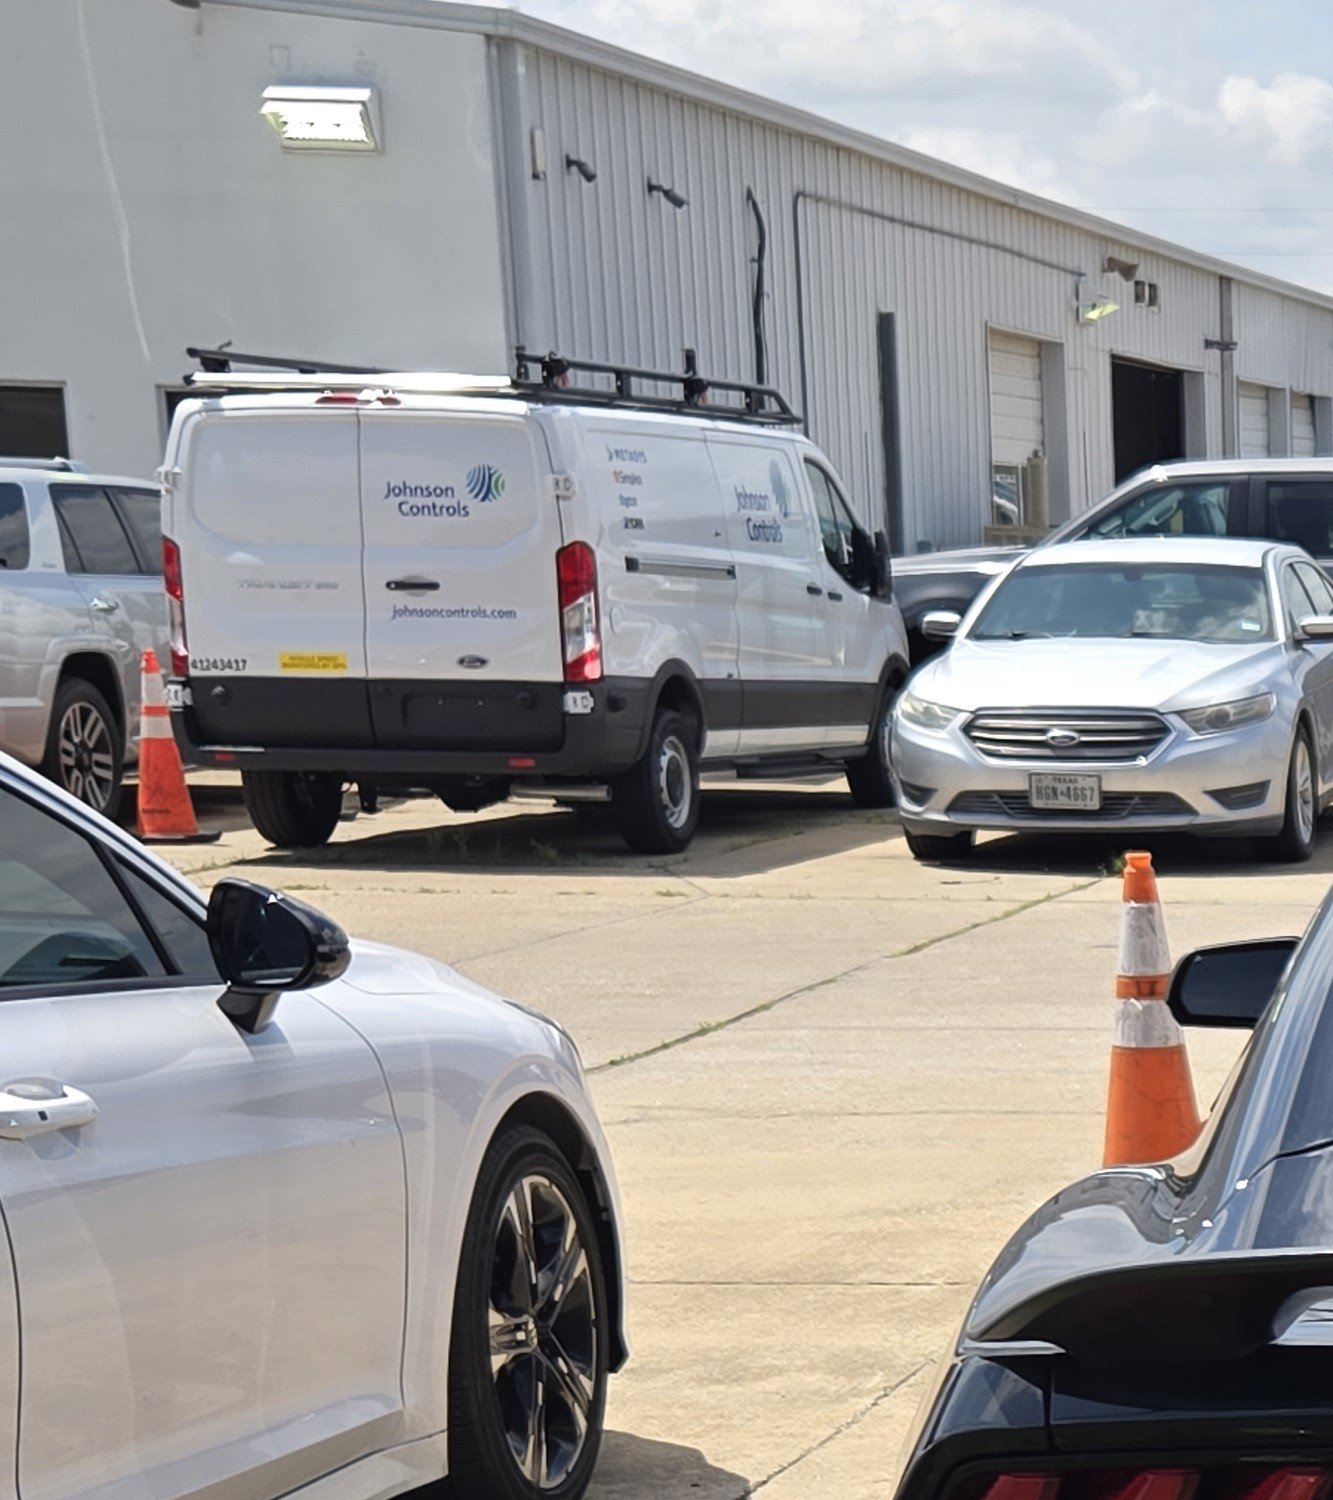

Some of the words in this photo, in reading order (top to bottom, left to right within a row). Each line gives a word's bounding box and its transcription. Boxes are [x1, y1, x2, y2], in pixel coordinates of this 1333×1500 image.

[384, 480, 455, 499] Johnson
[734, 484, 770, 512] Johnson
[398, 500, 470, 517] Controls
[746, 516, 782, 543] Controls
[391, 604, 517, 620] johnsoncontrols.com
[191, 657, 247, 672] 41243417
